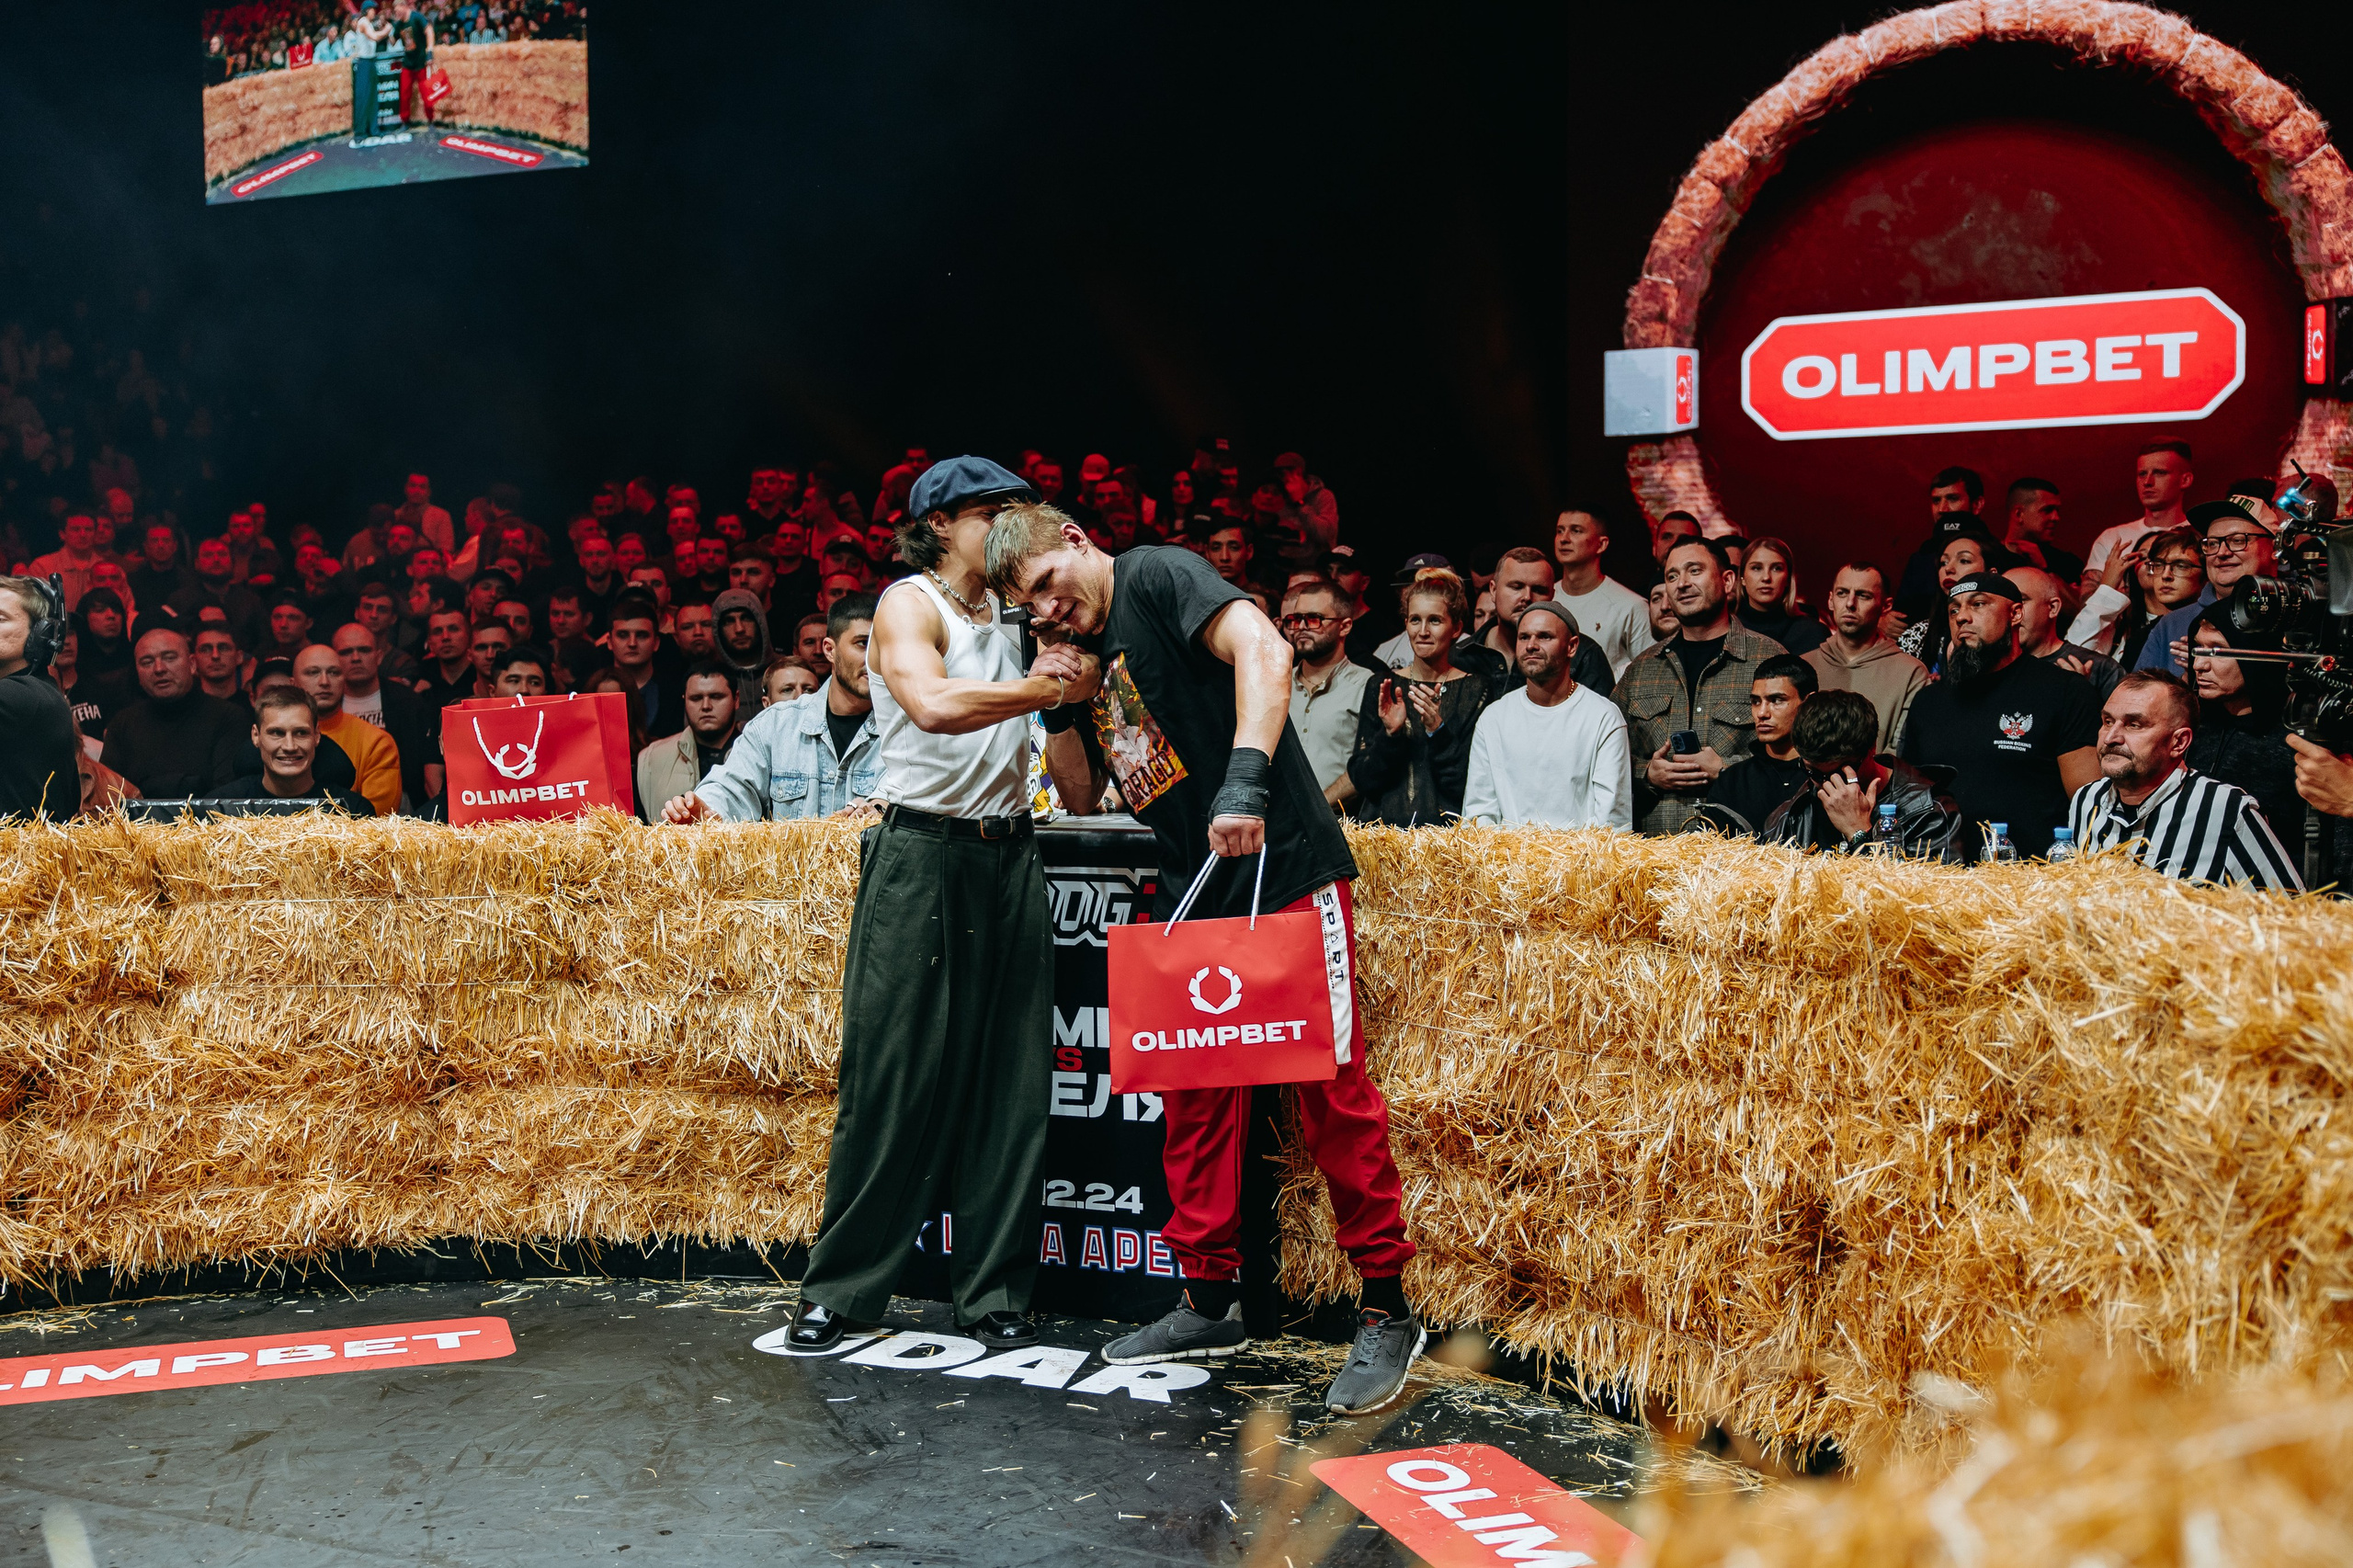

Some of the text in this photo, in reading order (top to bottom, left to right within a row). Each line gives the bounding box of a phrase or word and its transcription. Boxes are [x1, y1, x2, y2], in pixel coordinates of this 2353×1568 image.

[1781, 332, 2198, 399] OLIMPBET
[461, 780, 589, 805] OLIMPBET
[1131, 1020, 1307, 1052] OLIMPBET
[1041, 1179, 1144, 1214] 2.24
[0, 1329, 481, 1391] IMPBET
[1386, 1460, 1598, 1568] OLIM
